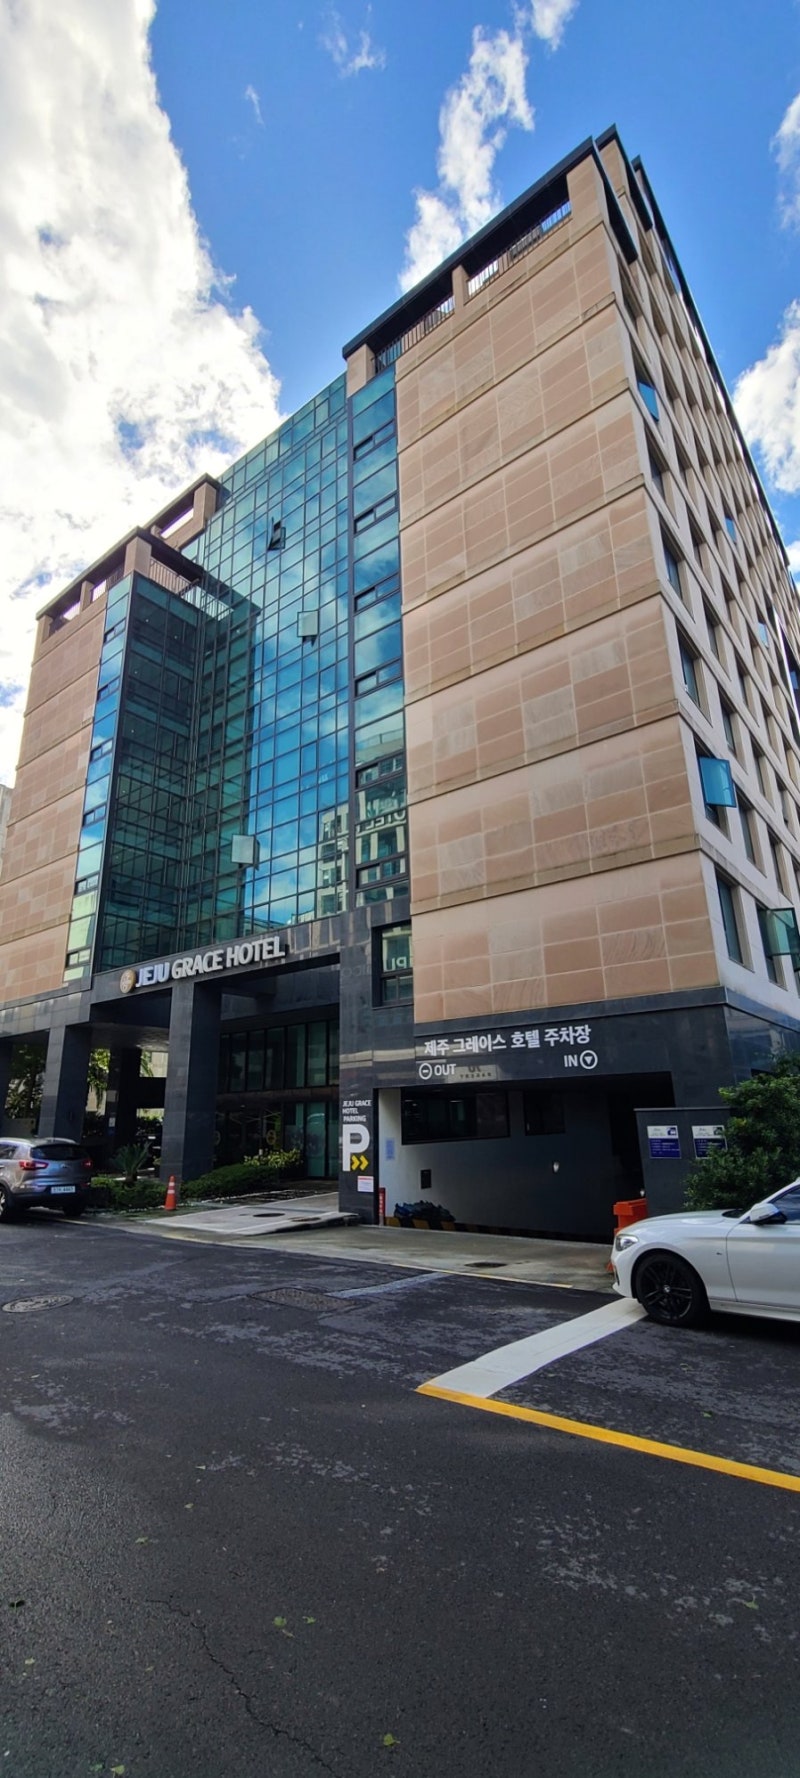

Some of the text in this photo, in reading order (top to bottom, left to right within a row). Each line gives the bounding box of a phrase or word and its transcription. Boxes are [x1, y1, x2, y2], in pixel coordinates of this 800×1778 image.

[135, 936, 286, 988] JEJU GRACE HOTEL
[424, 1024, 591, 1057] 제주 그레이스 호텔 주차장
[434, 1063, 457, 1076] OUT
[564, 1054, 578, 1067] IN
[342, 1123, 370, 1172] P
